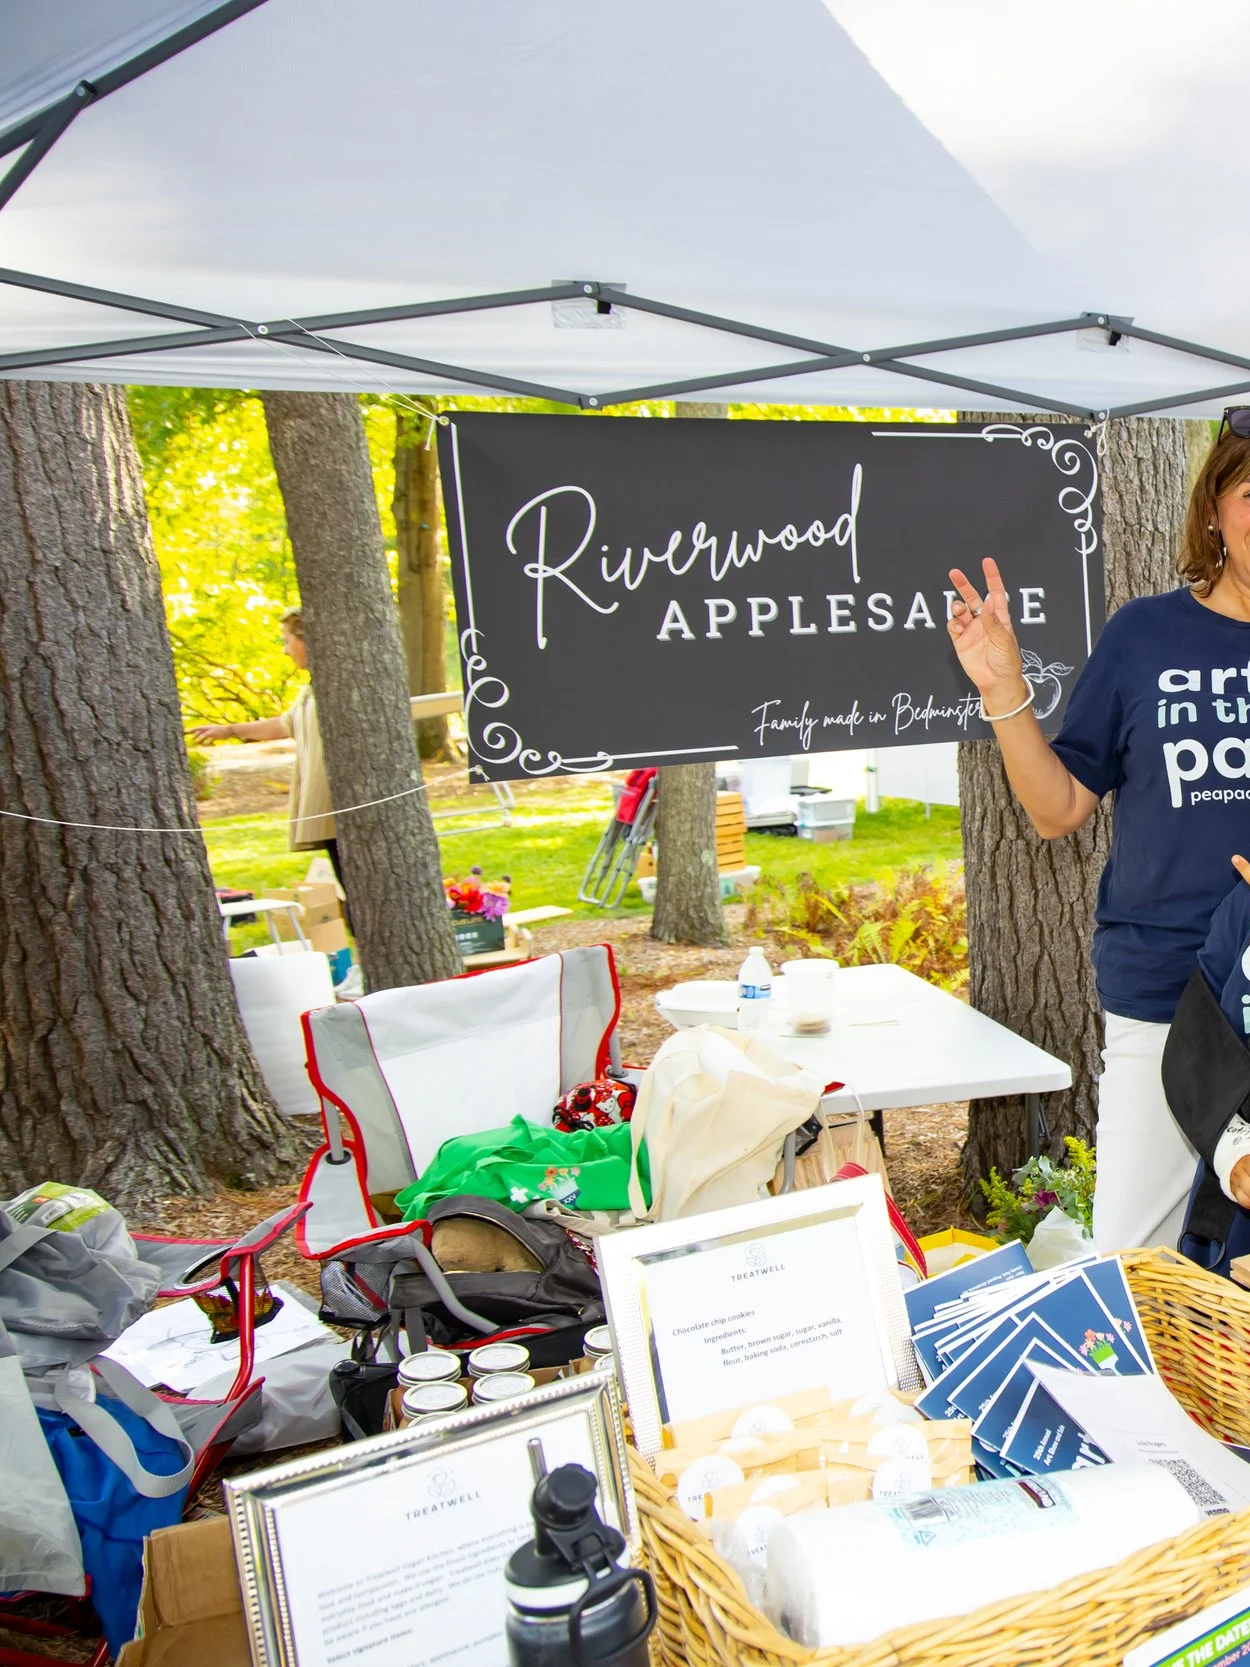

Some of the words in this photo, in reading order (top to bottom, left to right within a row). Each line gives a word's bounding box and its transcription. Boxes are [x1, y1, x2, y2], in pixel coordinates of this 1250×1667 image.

[507, 464, 862, 649] Riverwood
[656, 587, 1047, 640] APPLESAE
[751, 700, 818, 750] Family
[822, 707, 864, 735] made
[868, 708, 887, 727] in
[1157, 699, 1198, 729] in
[731, 1264, 786, 1283] TREATWELL
[672, 1320, 709, 1336] Chocolate
[710, 1316, 726, 1327] chip
[727, 1308, 755, 1322] cookies
[703, 1326, 748, 1344] Ingredients:
[720, 1342, 746, 1355] Butter,
[747, 1336, 771, 1347] brown
[772, 1330, 794, 1342] sugar,
[795, 1323, 816, 1336] sugar,
[817, 1316, 843, 1329] vanilla,
[722, 1355, 743, 1367] flour,
[744, 1348, 768, 1361] baking
[769, 1343, 788, 1354] soda,
[789, 1332, 828, 1348] cornstarch,
[829, 1328, 842, 1337] salt
[1032, 1444, 1045, 1460] 25th
[1042, 1453, 1053, 1466] Art
[1047, 1439, 1059, 1455] Show
[404, 1490, 482, 1521] TREATWELL
[1186, 1641, 1214, 1667] THE
